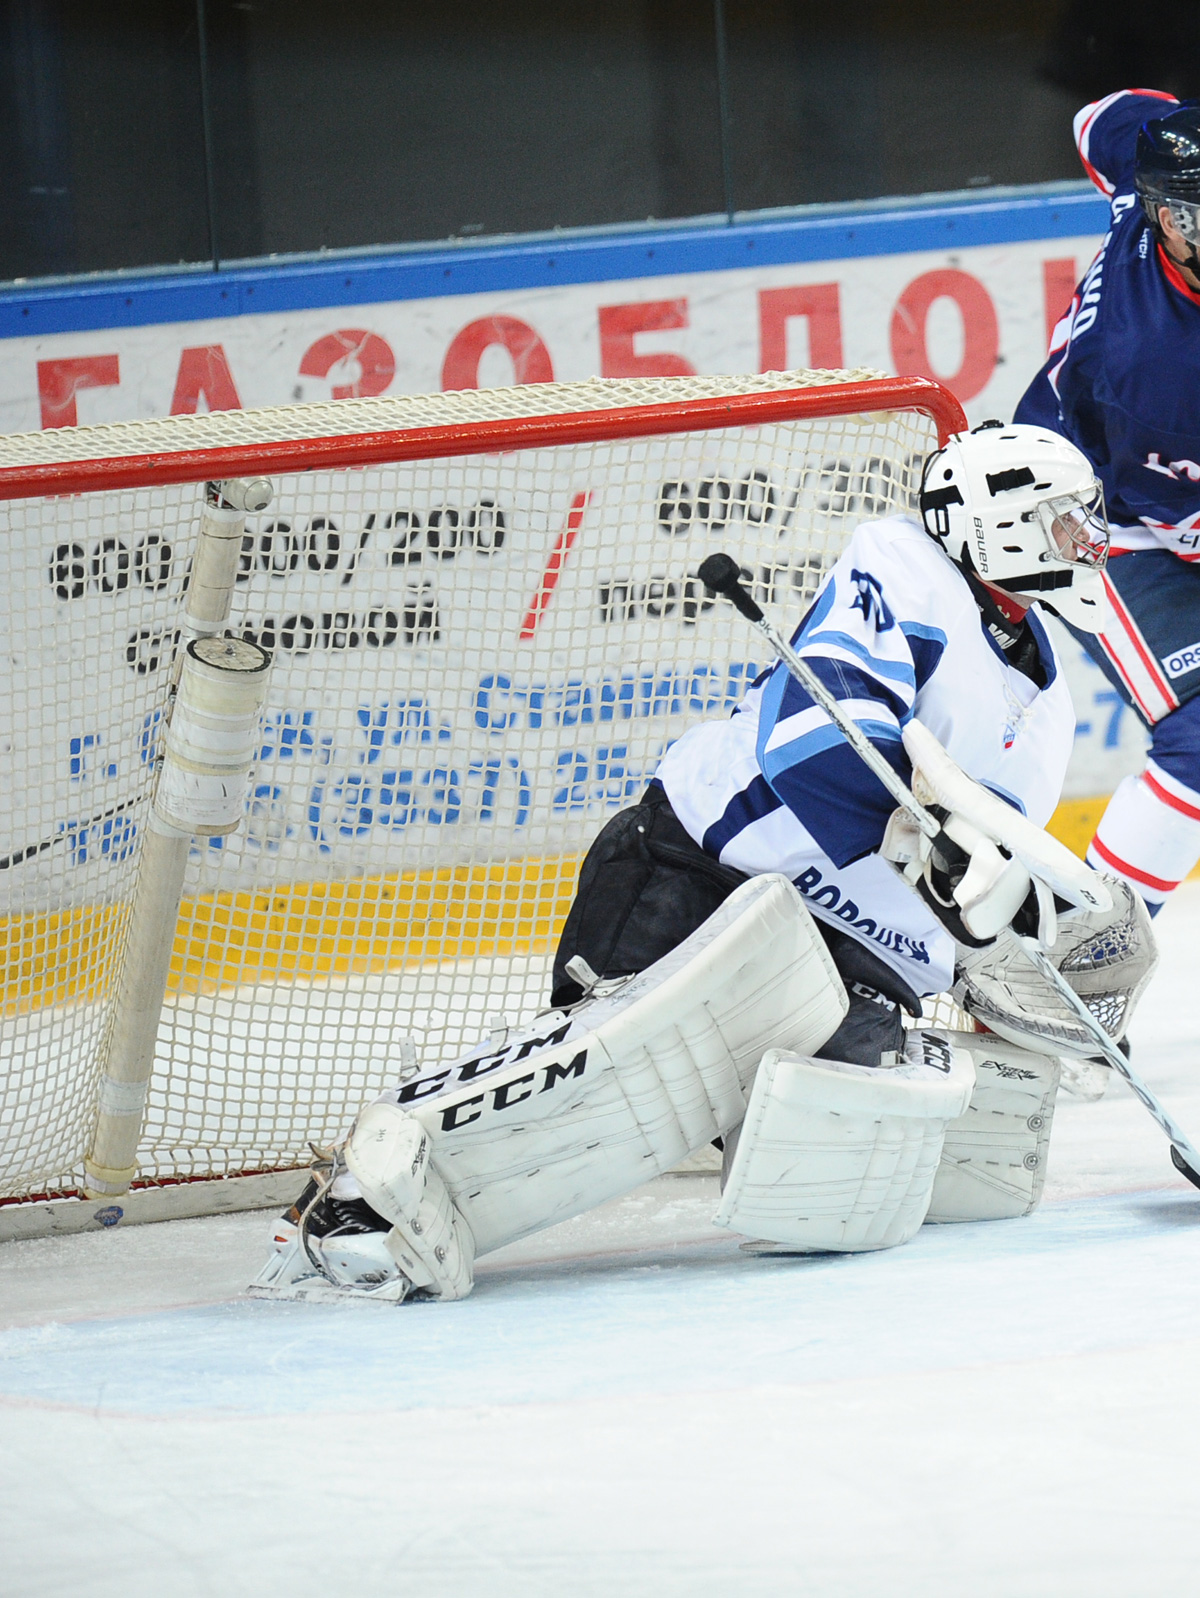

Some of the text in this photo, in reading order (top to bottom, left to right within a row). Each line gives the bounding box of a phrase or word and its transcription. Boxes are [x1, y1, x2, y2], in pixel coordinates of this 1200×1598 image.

[850, 980, 897, 1013] CM
[396, 1020, 573, 1105] CCM
[921, 1031, 951, 1075] CCM
[438, 1048, 589, 1133] CCM
